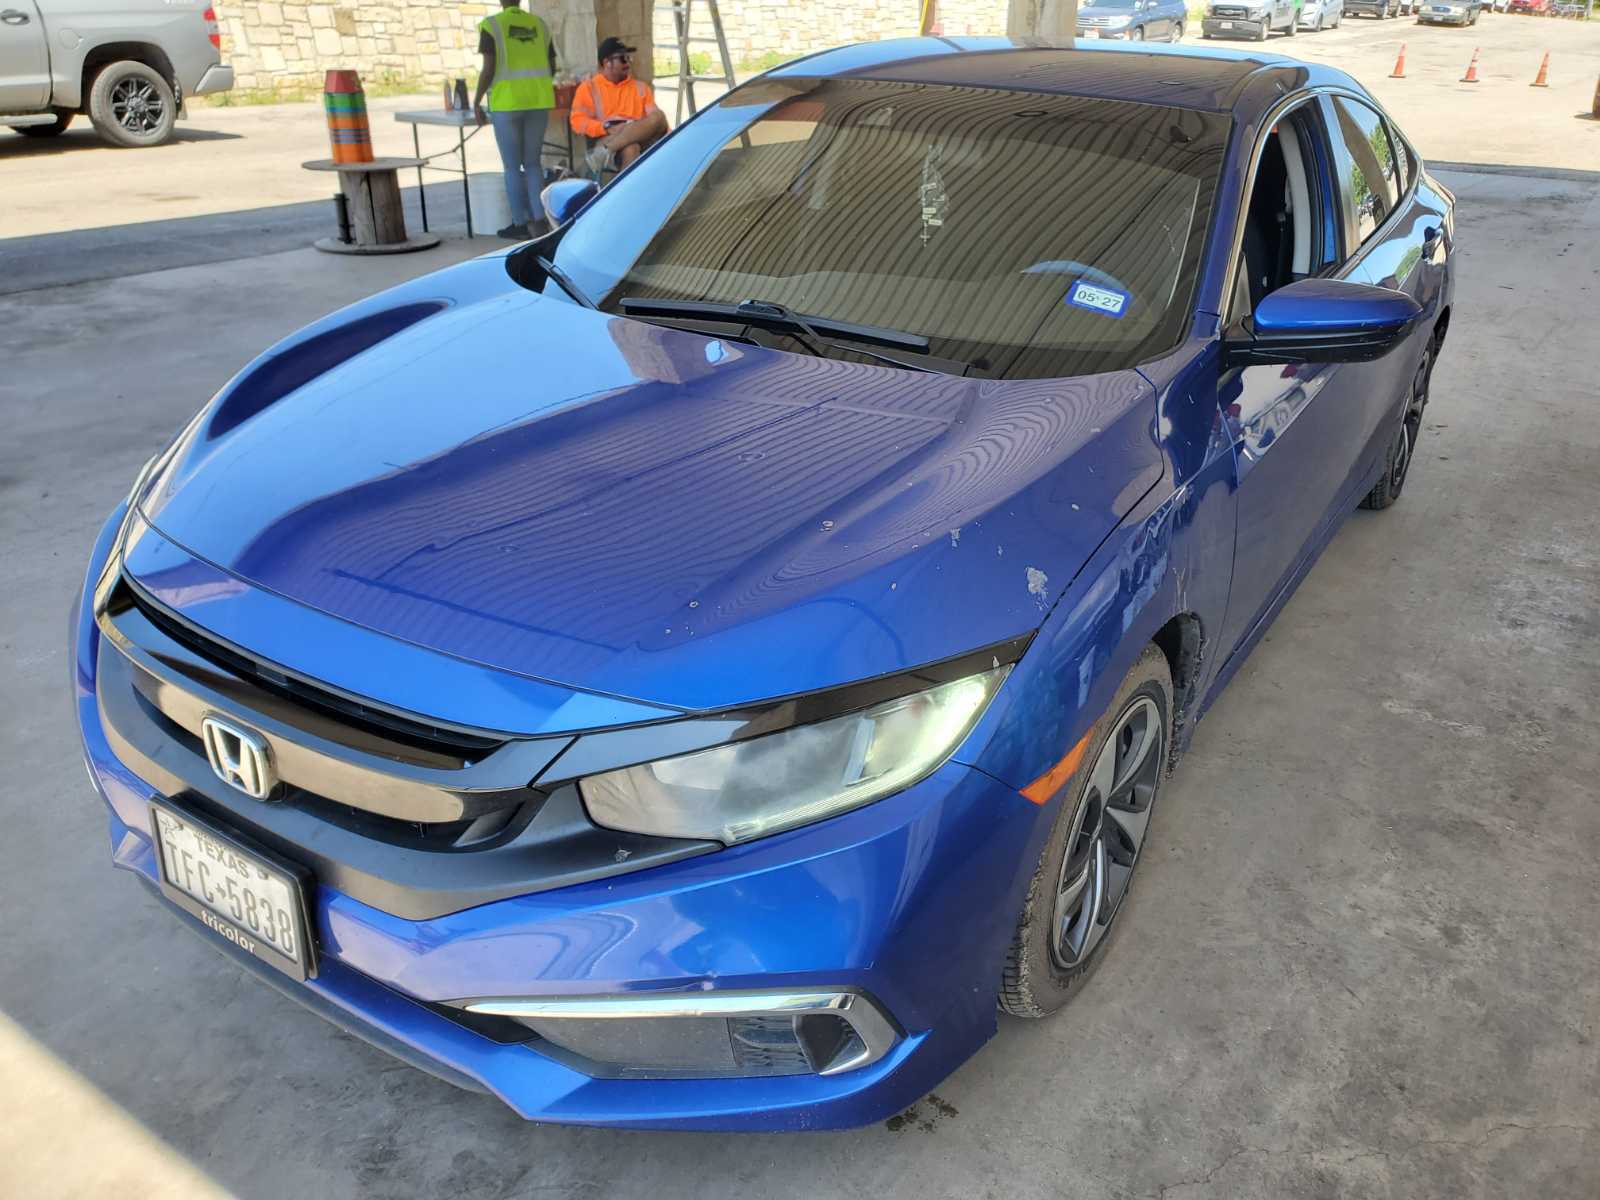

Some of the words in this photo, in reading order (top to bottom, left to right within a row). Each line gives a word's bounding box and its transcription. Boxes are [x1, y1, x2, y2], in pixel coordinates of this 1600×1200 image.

[1078, 290, 1095, 302] 05
[1102, 297, 1120, 308] 27
[195, 832, 249, 879] TEXAS
[201, 909, 255, 953] tricolor
